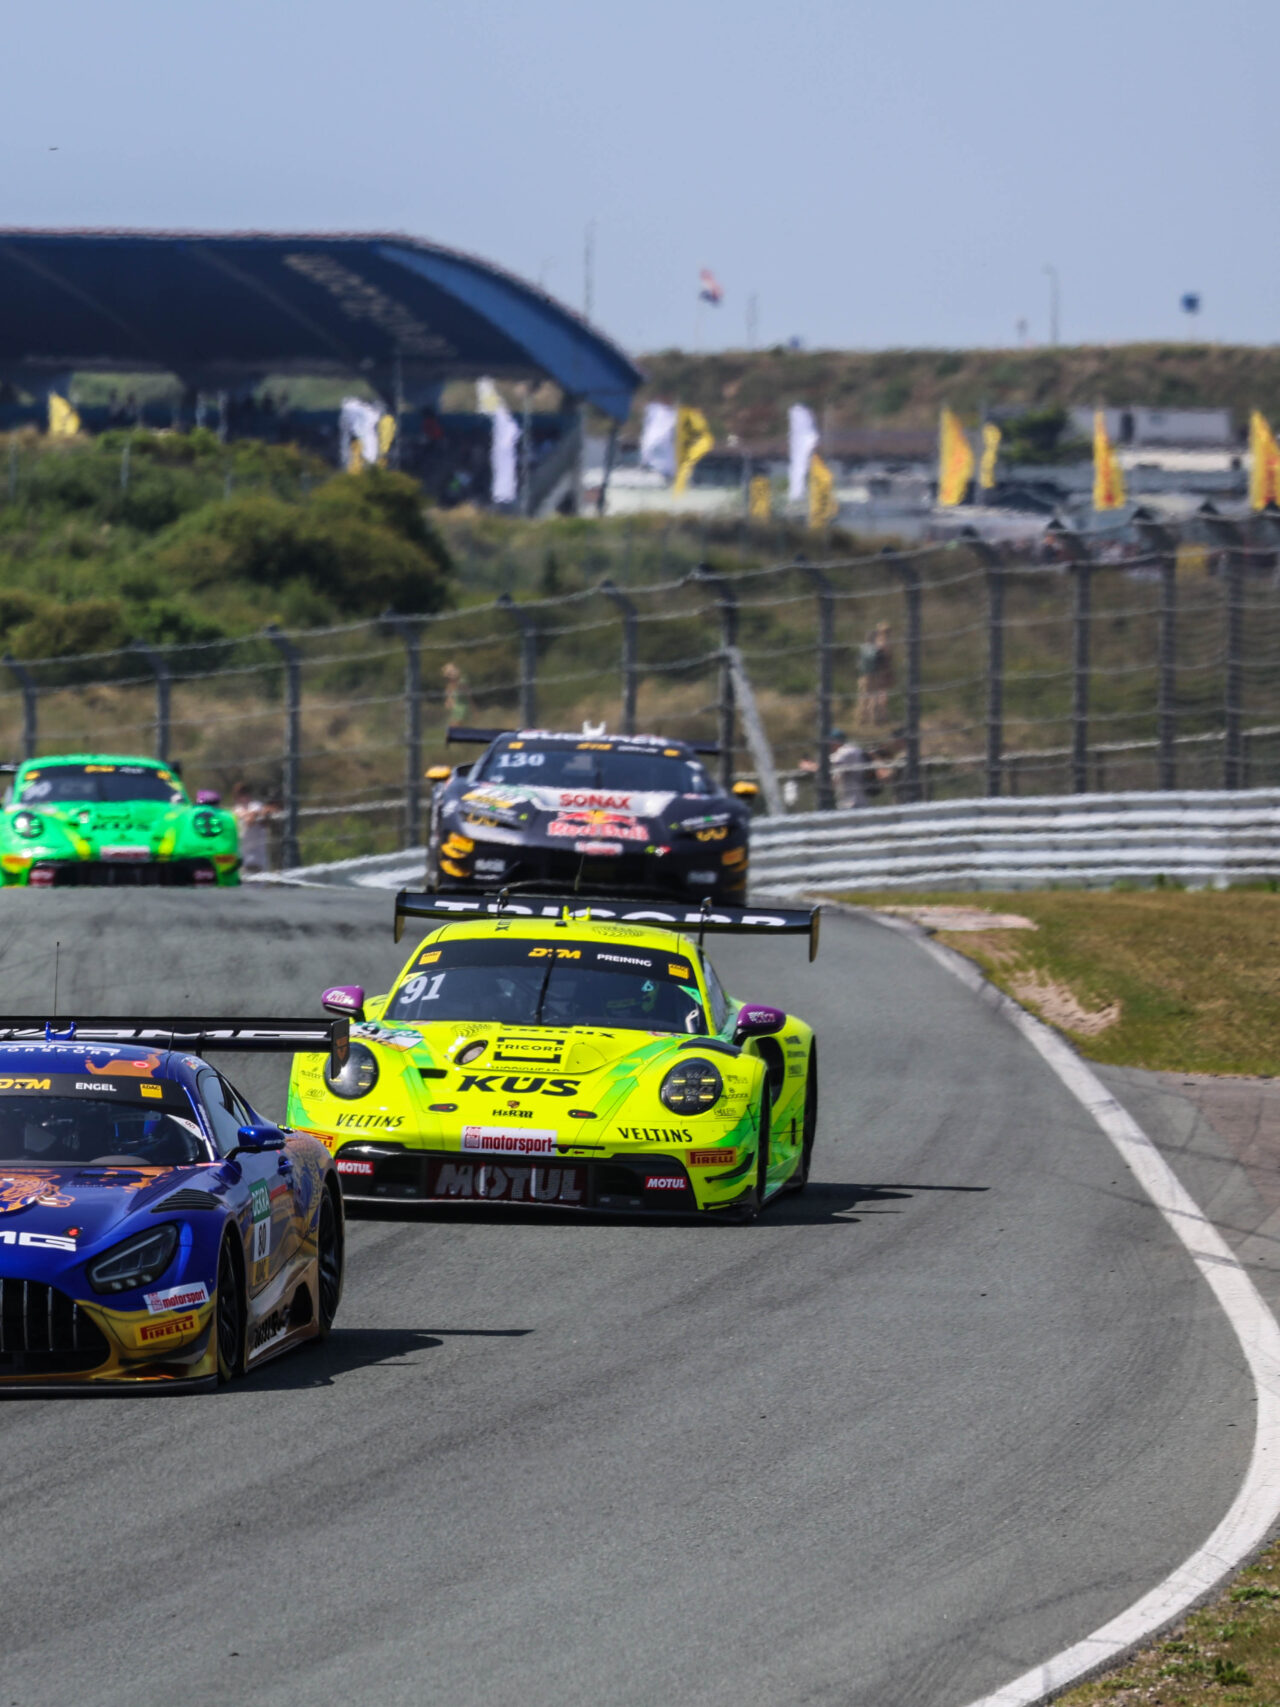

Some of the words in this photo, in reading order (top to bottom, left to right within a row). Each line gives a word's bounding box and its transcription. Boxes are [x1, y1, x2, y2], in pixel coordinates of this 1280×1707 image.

[560, 793, 631, 810] SONAX
[547, 821, 597, 838] Red
[528, 947, 582, 959] DTM
[597, 953, 653, 967] PREINING
[400, 973, 446, 1005] 91
[495, 1043, 564, 1052] TRICORP
[75, 1082, 117, 1092] ENGEL
[457, 1075, 582, 1097] KÜS
[335, 1113, 406, 1128] VELTINS
[617, 1127, 693, 1143] VELTINS
[481, 1134, 553, 1154] motorsport
[690, 1150, 734, 1165] PIRELLI
[337, 1161, 372, 1174] MOTUL
[434, 1163, 584, 1201] MOTUL
[647, 1178, 686, 1189] MOTUL
[257, 1222, 267, 1257] 80
[162, 1288, 207, 1309] motorsport
[140, 1314, 195, 1341] PIRELLI
